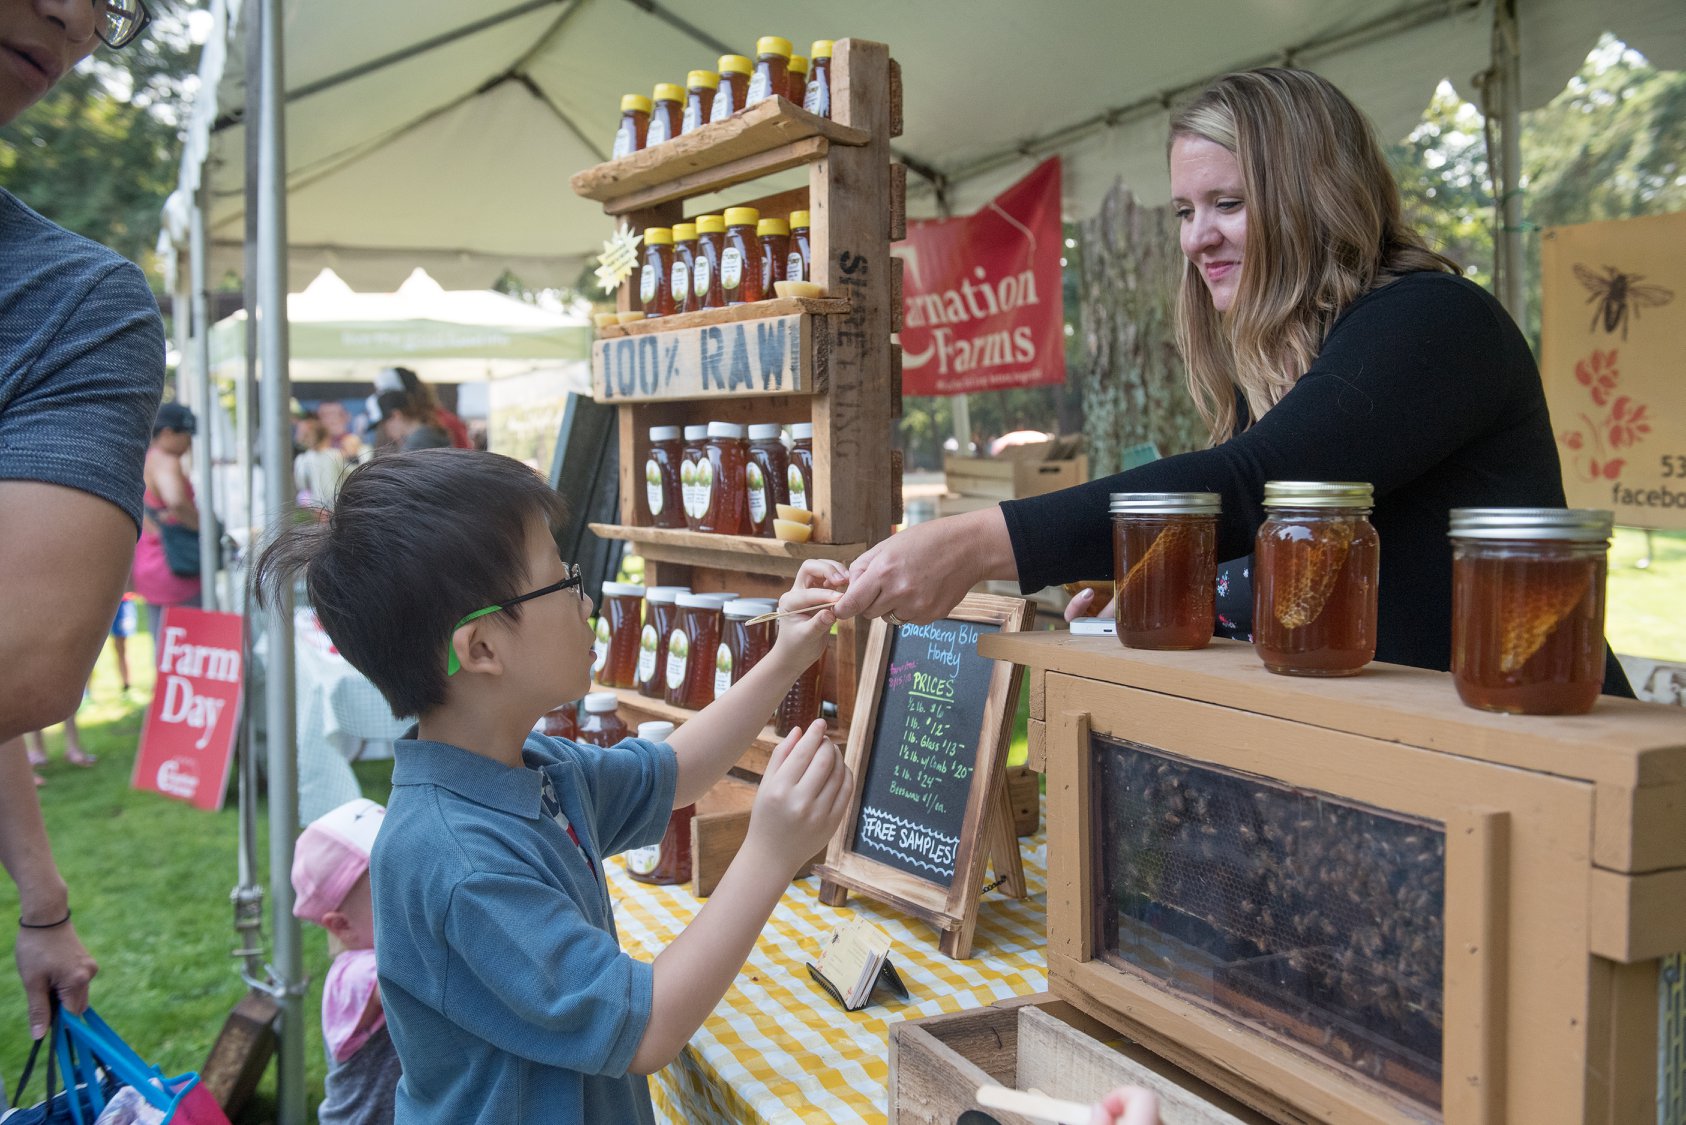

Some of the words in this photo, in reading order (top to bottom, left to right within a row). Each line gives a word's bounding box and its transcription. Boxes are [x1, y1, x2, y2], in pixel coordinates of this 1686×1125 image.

[601, 335, 680, 399] 100%
[932, 326, 1036, 374] Farms
[159, 626, 241, 683] Farm
[928, 642, 961, 678] Honey
[913, 671, 954, 697] PRICES
[160, 675, 225, 750] Day
[866, 817, 897, 842] FREE
